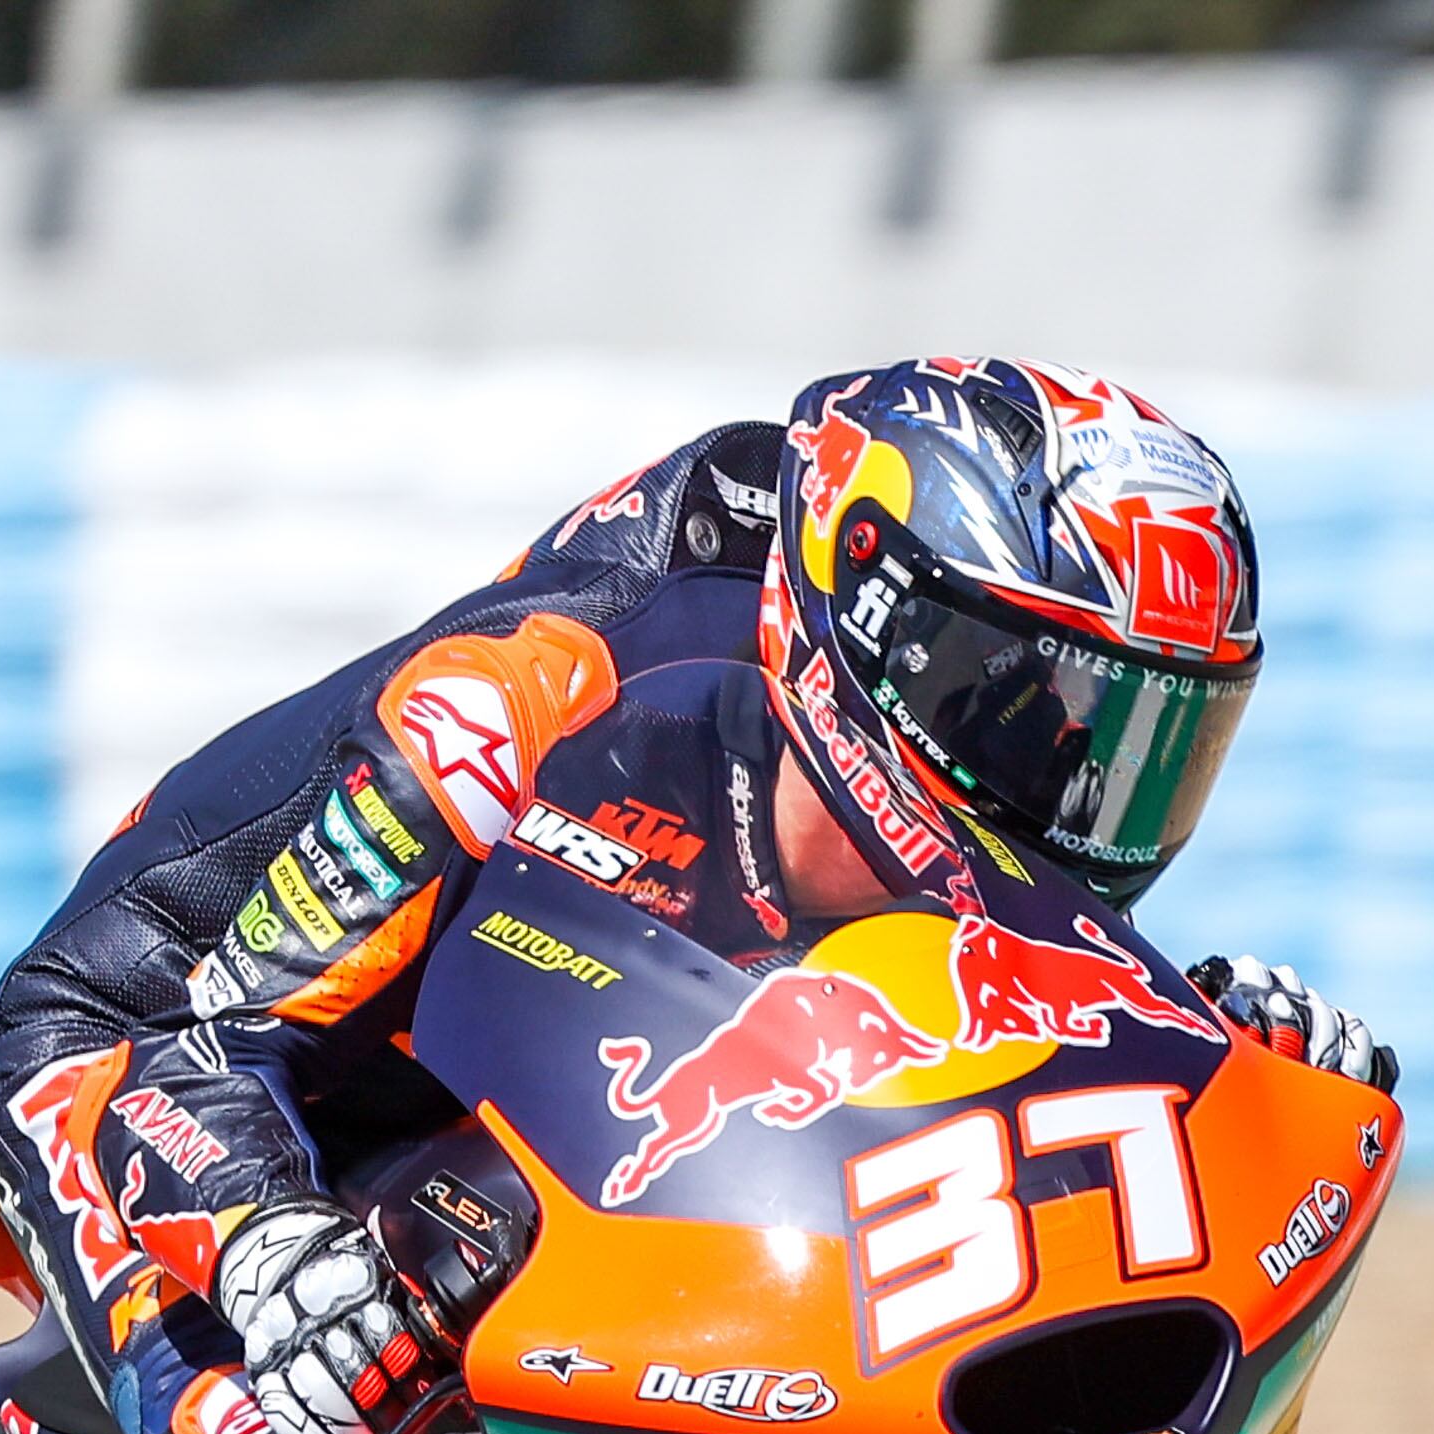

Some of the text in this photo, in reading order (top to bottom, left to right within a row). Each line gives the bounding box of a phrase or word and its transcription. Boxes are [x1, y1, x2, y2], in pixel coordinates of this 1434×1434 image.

[1037, 636, 1125, 681] GIVES
[1142, 667, 1195, 697] YOU
[329, 811, 393, 892] MOTOREX
[514, 804, 641, 881] WRS
[588, 797, 706, 871] KTM
[726, 762, 760, 889] alpinestars
[277, 865, 330, 937] DUNLOP
[471, 911, 623, 990] MOTOBATT
[110, 1086, 232, 1185] AVANT
[846, 1084, 1208, 1371] 37
